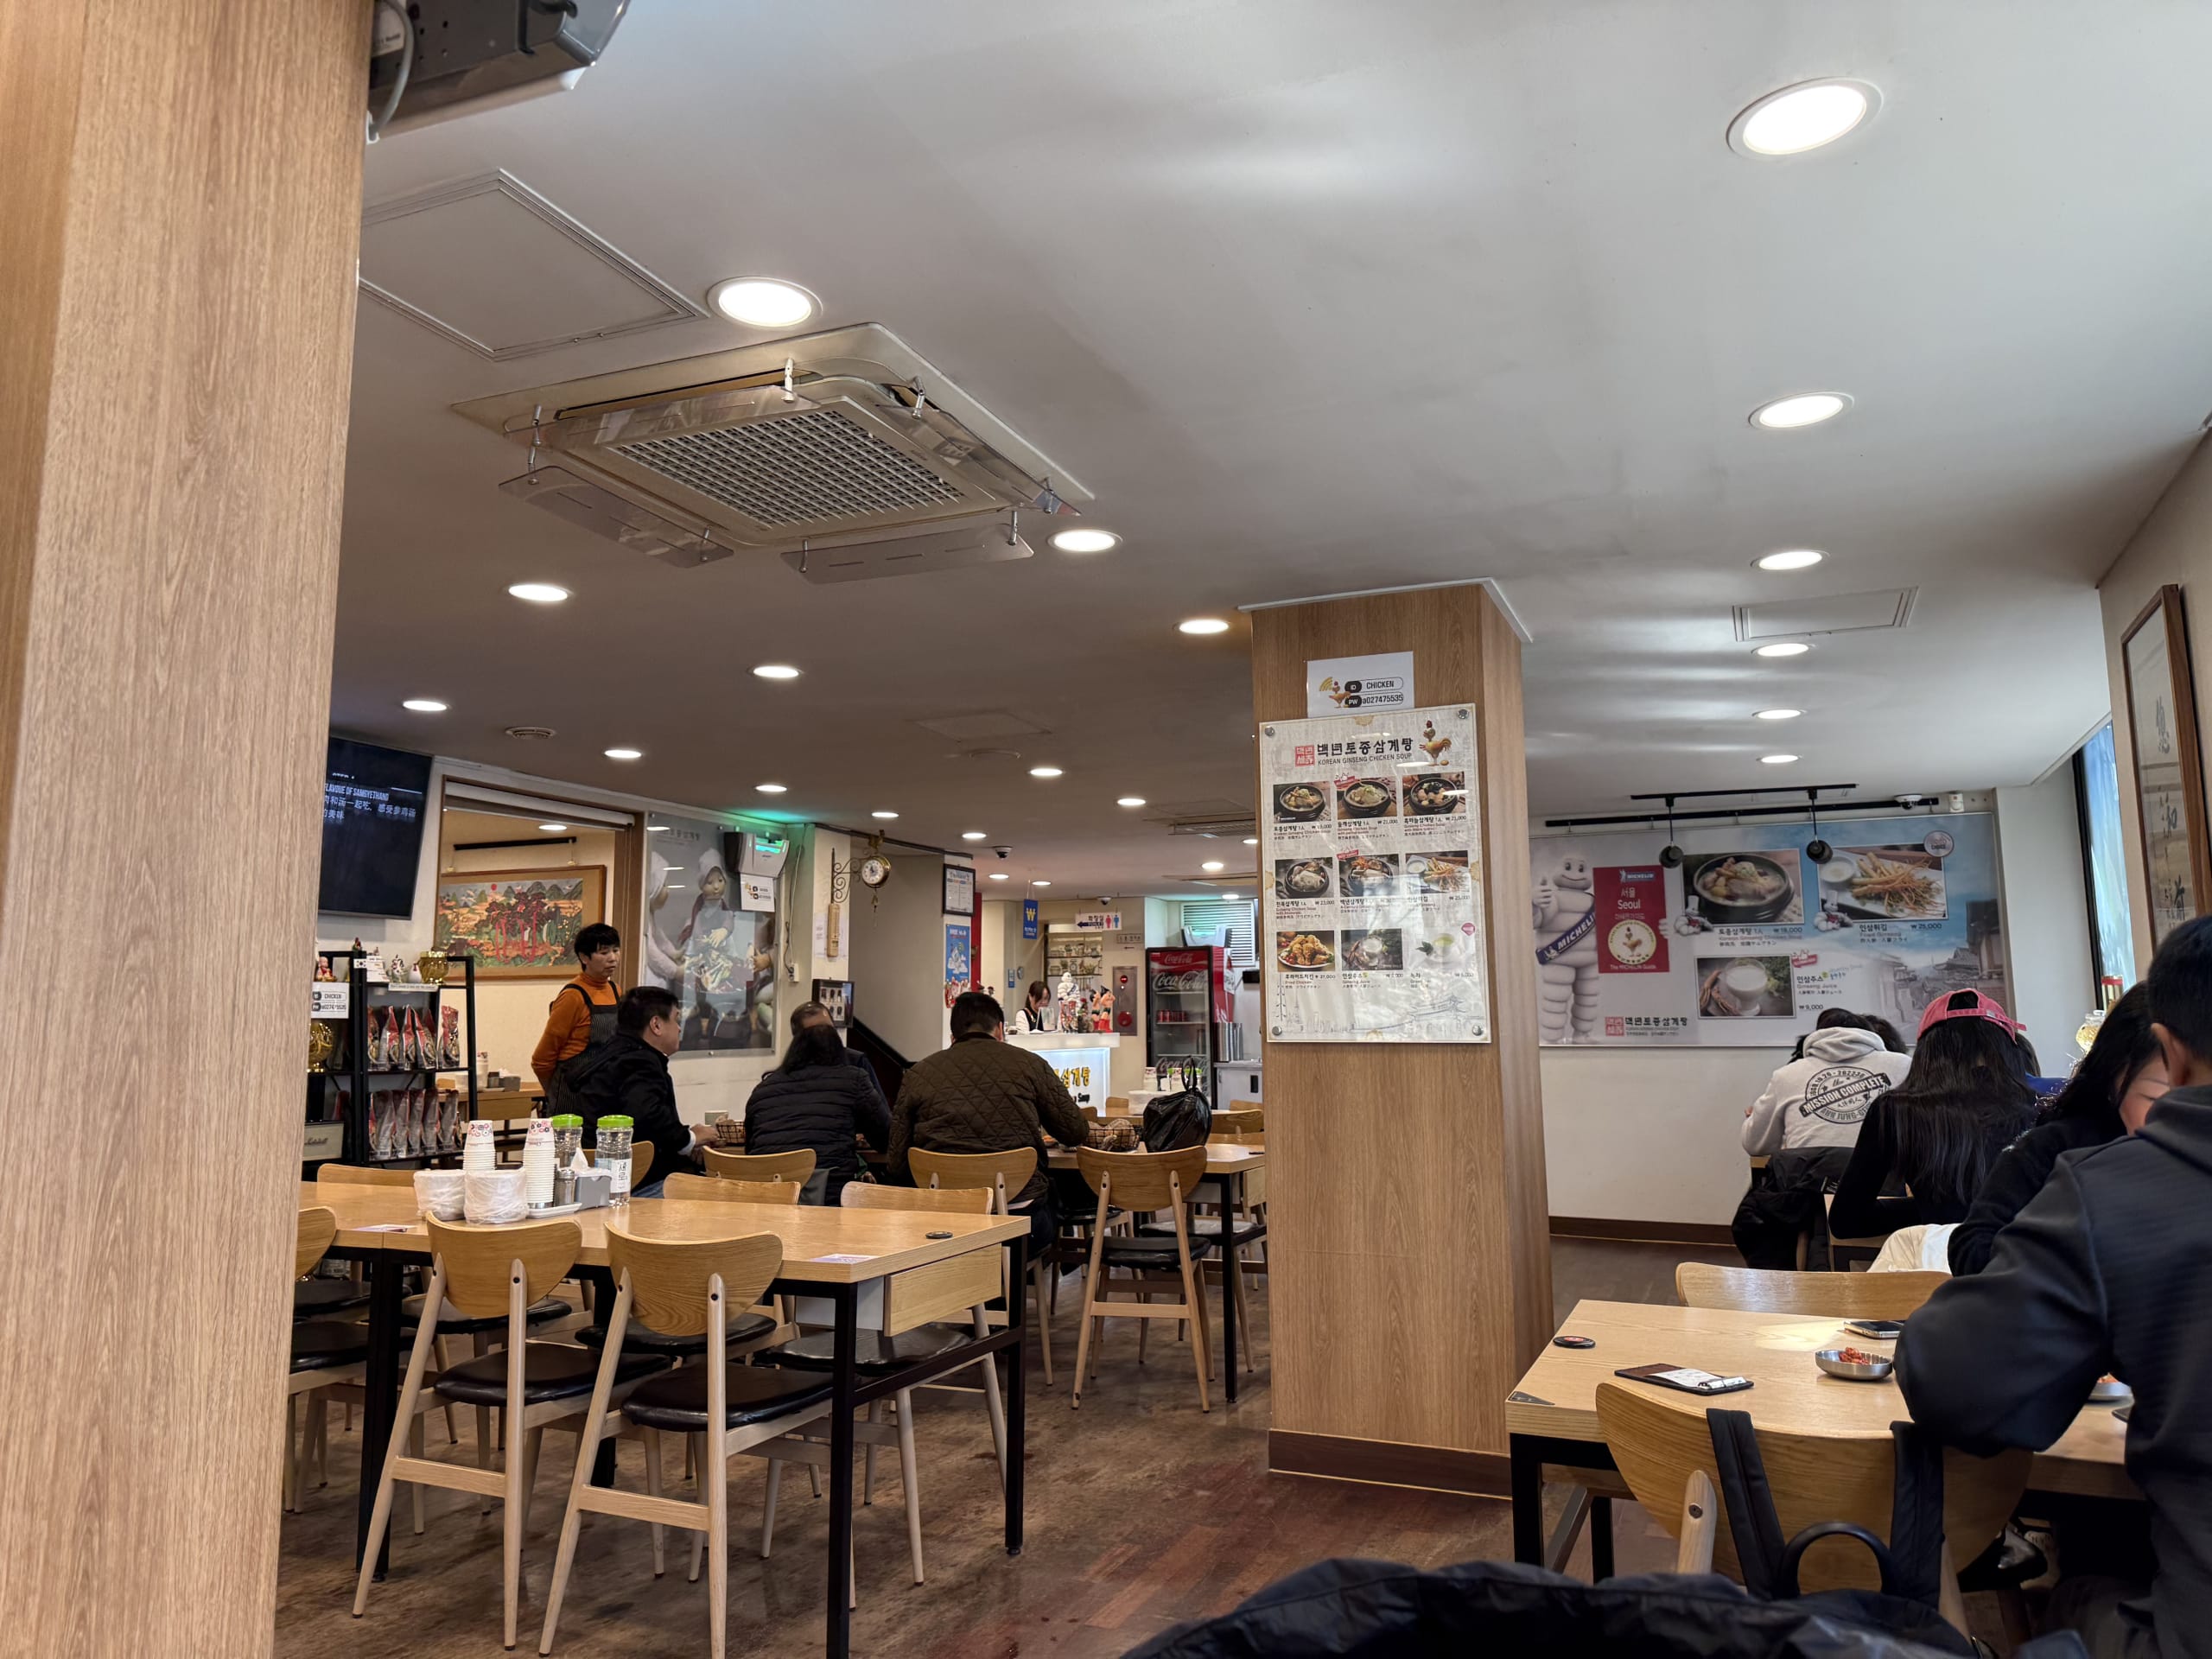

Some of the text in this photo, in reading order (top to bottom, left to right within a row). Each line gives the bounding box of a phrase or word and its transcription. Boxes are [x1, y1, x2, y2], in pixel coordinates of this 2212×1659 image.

[1366, 680, 1395, 690] CHICKEN
[1362, 694, 1404, 704] a027475535
[1317, 738, 1414, 757] 백년토종삼계탕
[1617, 899, 1641, 910] Seoul
[1557, 912, 1596, 950] MICHELI
[1153, 969, 1208, 990] Coca-Cola
[1803, 1090, 1841, 1114] MISSION
[1840, 1076, 1885, 1097] COMPLETE
